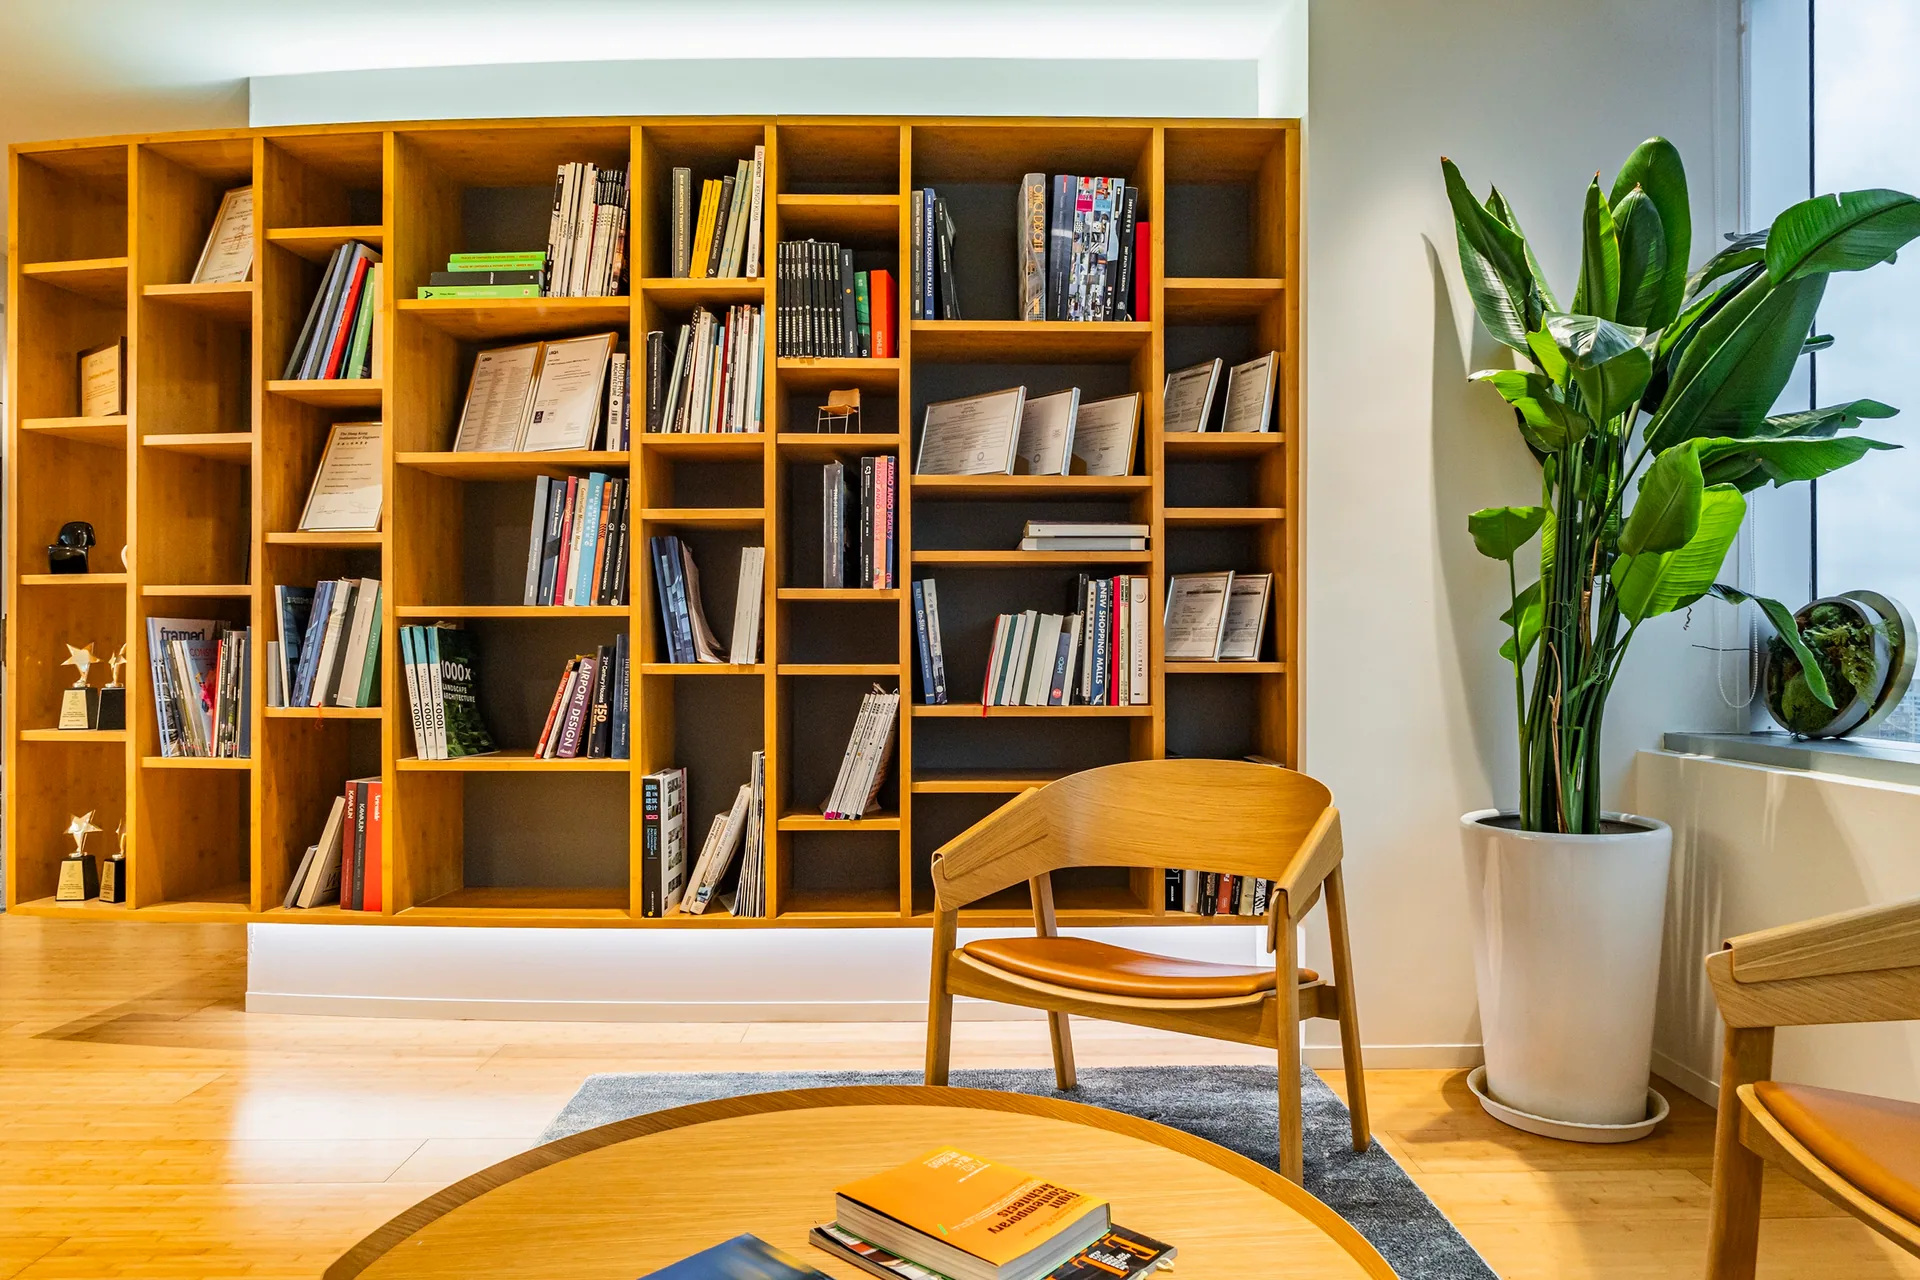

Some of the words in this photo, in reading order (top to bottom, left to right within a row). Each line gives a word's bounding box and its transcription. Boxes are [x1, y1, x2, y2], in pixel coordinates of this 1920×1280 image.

[753, 184, 761, 205] KENGO
[615, 362, 625, 397] MODERN
[587, 506, 598, 547] INTEGRATION
[1098, 586, 1107, 608] NEW
[160, 626, 205, 641] framed
[1096, 609, 1106, 655] SHOPPING
[599, 664, 608, 685] Century
[1094, 656, 1104, 685] MALLS
[443, 683, 467, 694] LANDSCAPE
[573, 661, 593, 706] AIRPORT
[443, 692, 476, 703] ARCHITECTURE
[596, 702, 607, 723] 150
[562, 707, 581, 747] DESIGN
[700, 832, 715, 857] Engineering
[984, 1186, 1069, 1235] Contemporary
[994, 1182, 1057, 1218] Architects
[1045, 1190, 1081, 1209] Eight
